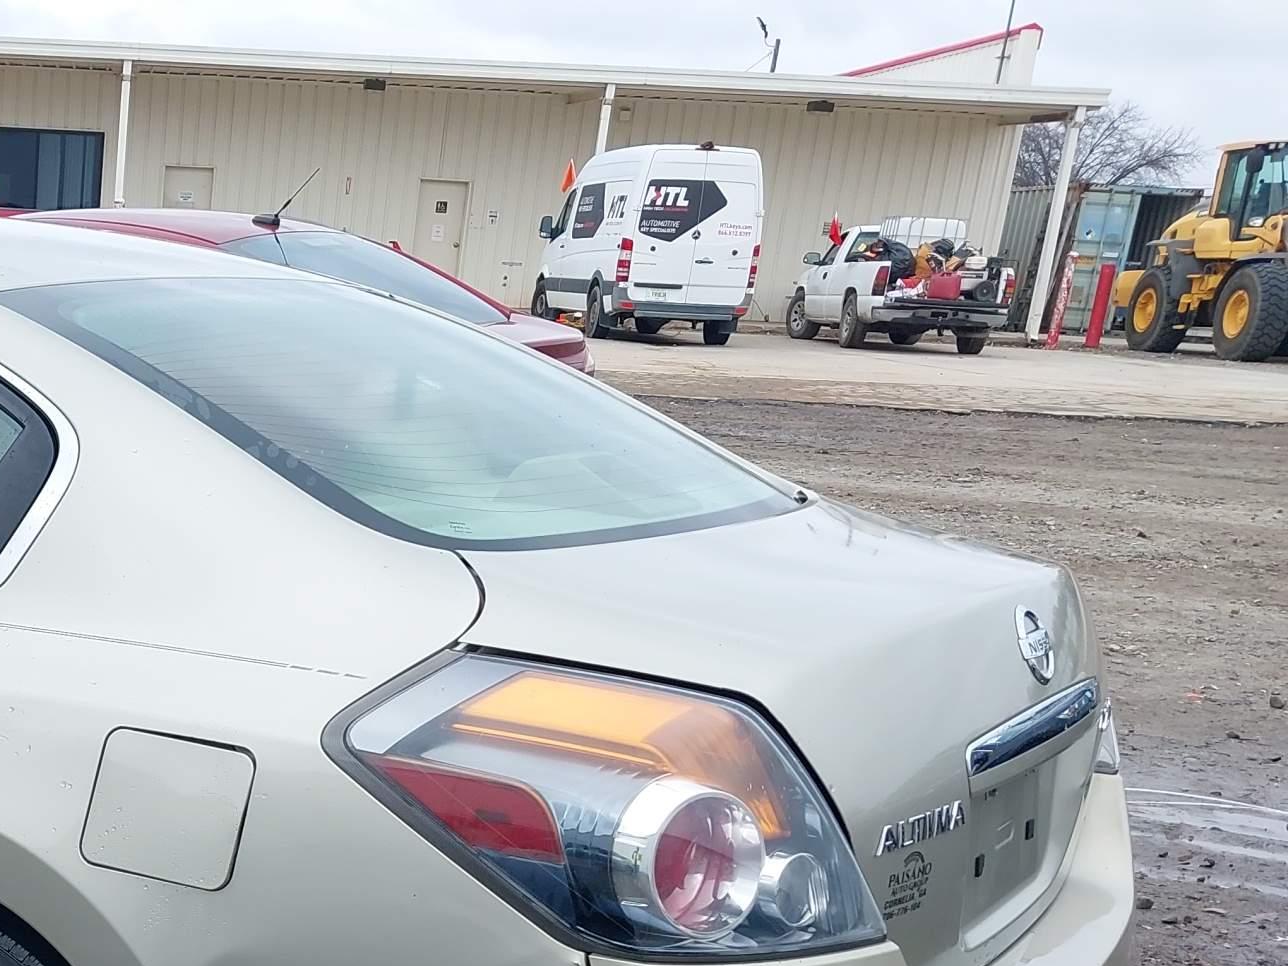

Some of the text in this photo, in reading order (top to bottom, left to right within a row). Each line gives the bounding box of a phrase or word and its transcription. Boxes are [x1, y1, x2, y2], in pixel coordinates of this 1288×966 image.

[607, 194, 628, 219] HTL
[644, 186, 690, 207] HTL
[640, 219, 681, 228] AUTOMOTIVE
[874, 800, 966, 857] ALTIMA
[888, 862, 932, 889] PAISANO
